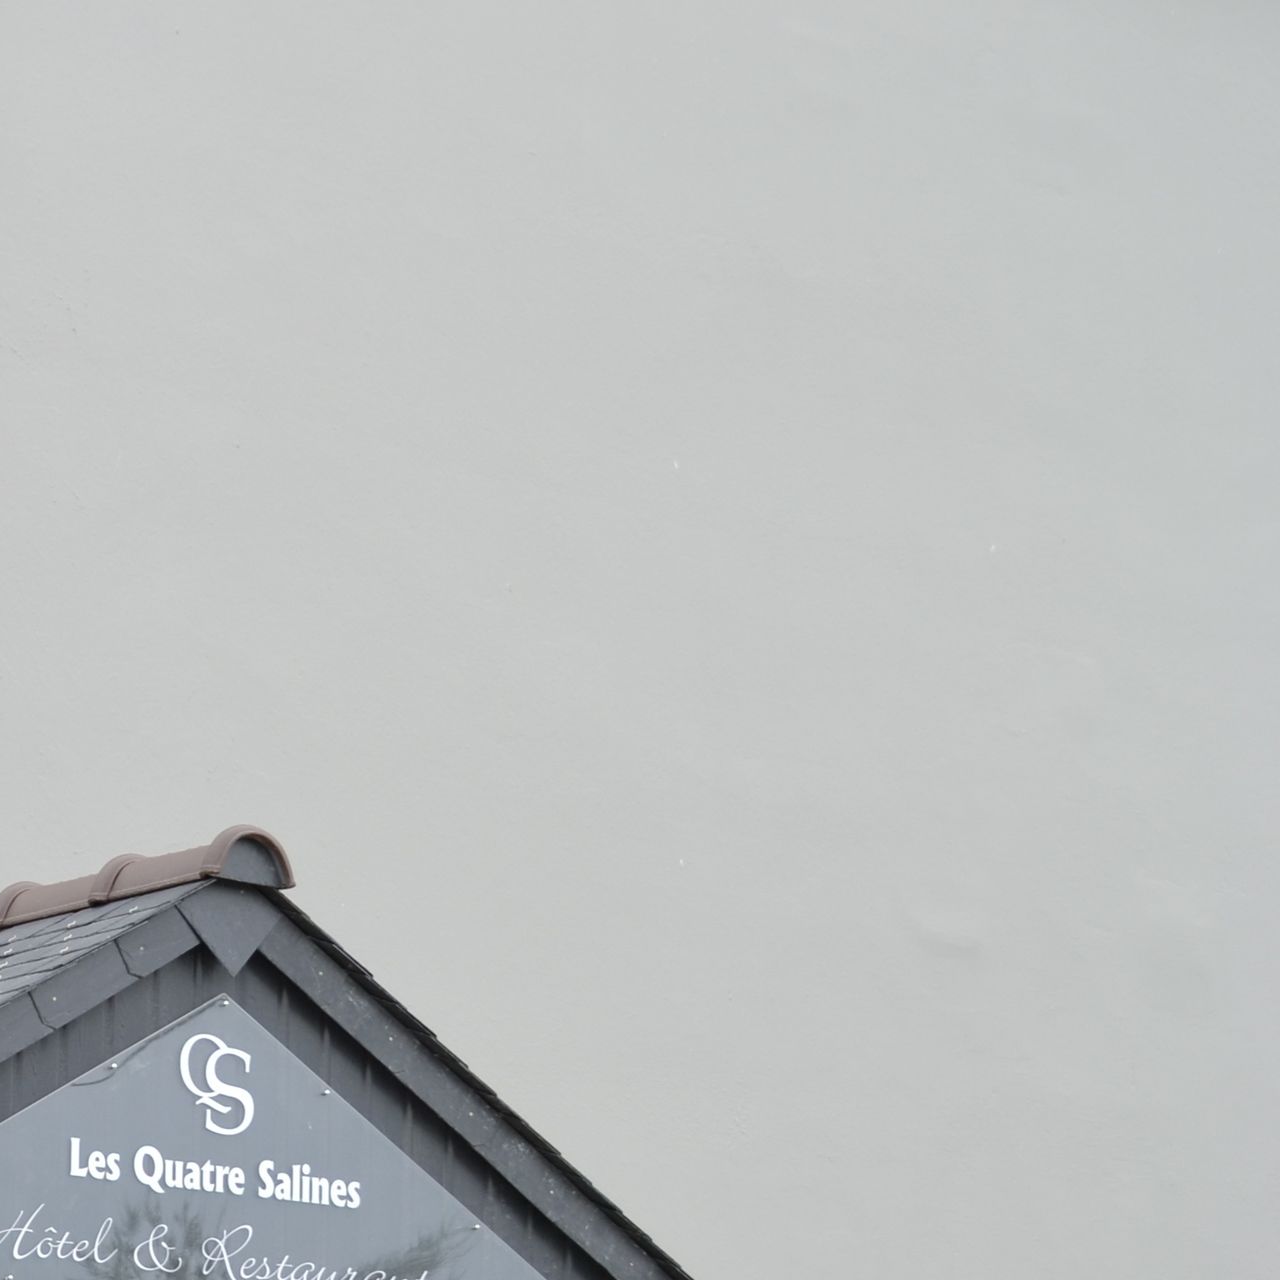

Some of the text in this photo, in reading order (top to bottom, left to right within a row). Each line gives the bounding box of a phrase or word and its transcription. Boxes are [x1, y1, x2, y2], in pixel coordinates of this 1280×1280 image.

[70, 1137, 361, 1208] Les Quatre Salines
[133, 1224, 182, 1272] &
